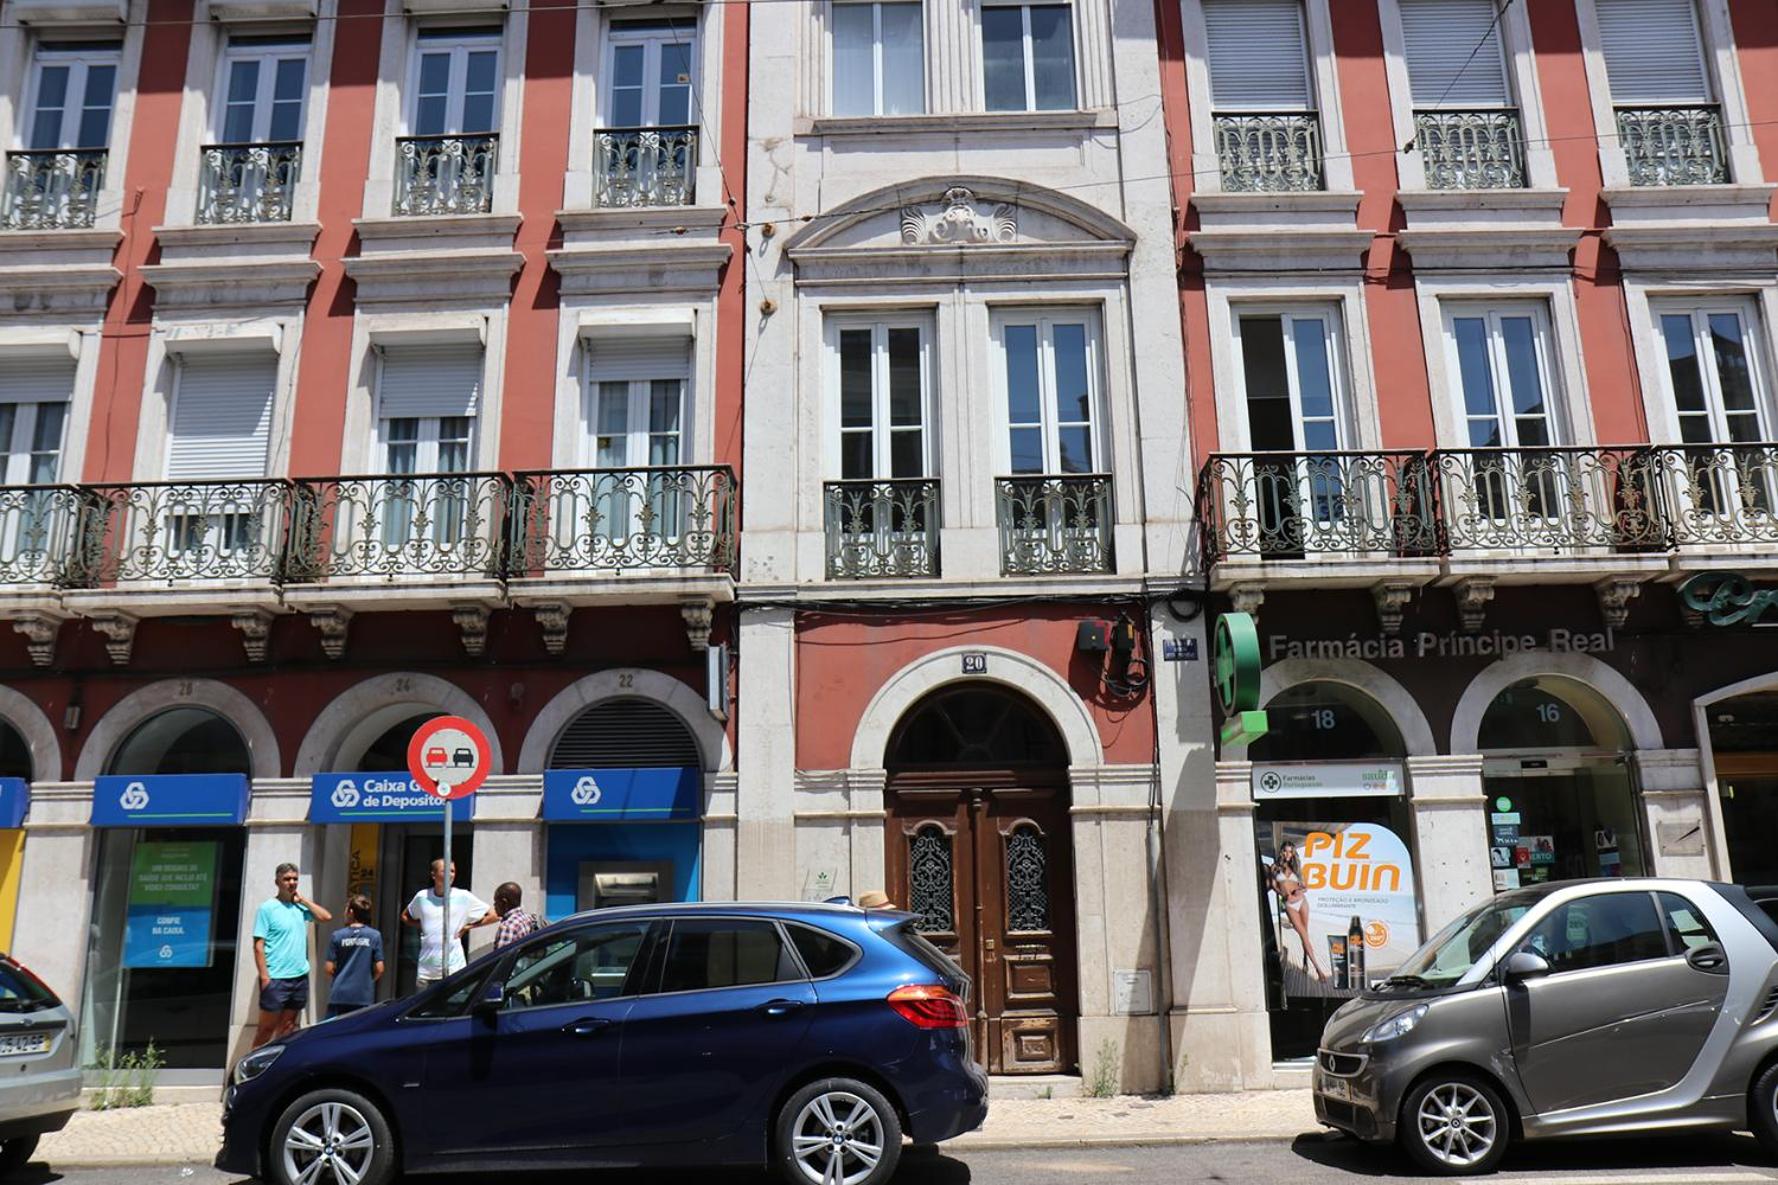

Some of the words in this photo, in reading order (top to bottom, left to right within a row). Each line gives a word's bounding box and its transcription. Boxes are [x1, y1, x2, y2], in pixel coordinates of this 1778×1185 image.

[1269, 632, 1405, 660] Farmácia
[1418, 629, 1536, 661] Príncipe
[1550, 626, 1614, 653] Real
[965, 656, 984, 670] 20
[619, 674, 633, 688] 22
[1311, 710, 1335, 729] 18
[1536, 703, 1560, 722] 16
[364, 779, 405, 793] Caixa
[363, 795, 379, 807] de
[1304, 832, 1372, 859] PIZ
